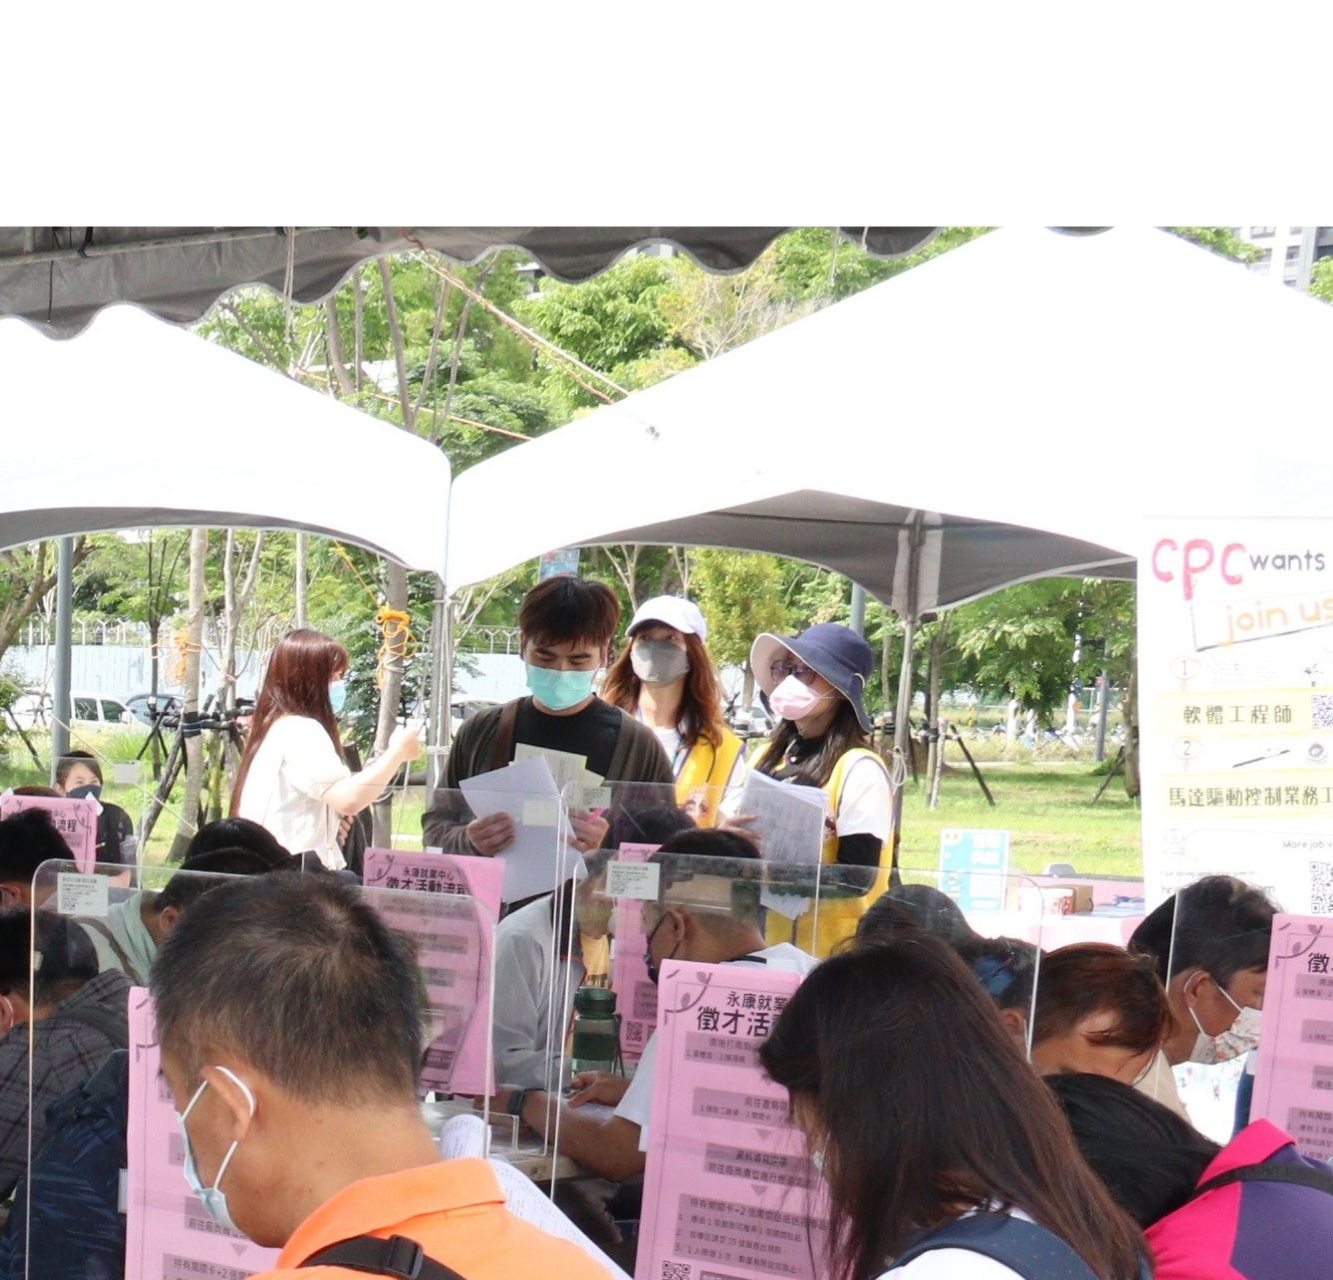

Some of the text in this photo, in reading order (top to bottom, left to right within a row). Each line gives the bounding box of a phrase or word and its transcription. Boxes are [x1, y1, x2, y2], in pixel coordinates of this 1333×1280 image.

[1250, 549, 1326, 572] wants
[1218, 600, 1290, 648] join
[1183, 704, 1293, 725] 軟體工程師
[1283, 840, 1308, 849] More
[1309, 840, 1325, 851] job
[1307, 952, 1333, 974] 徵
